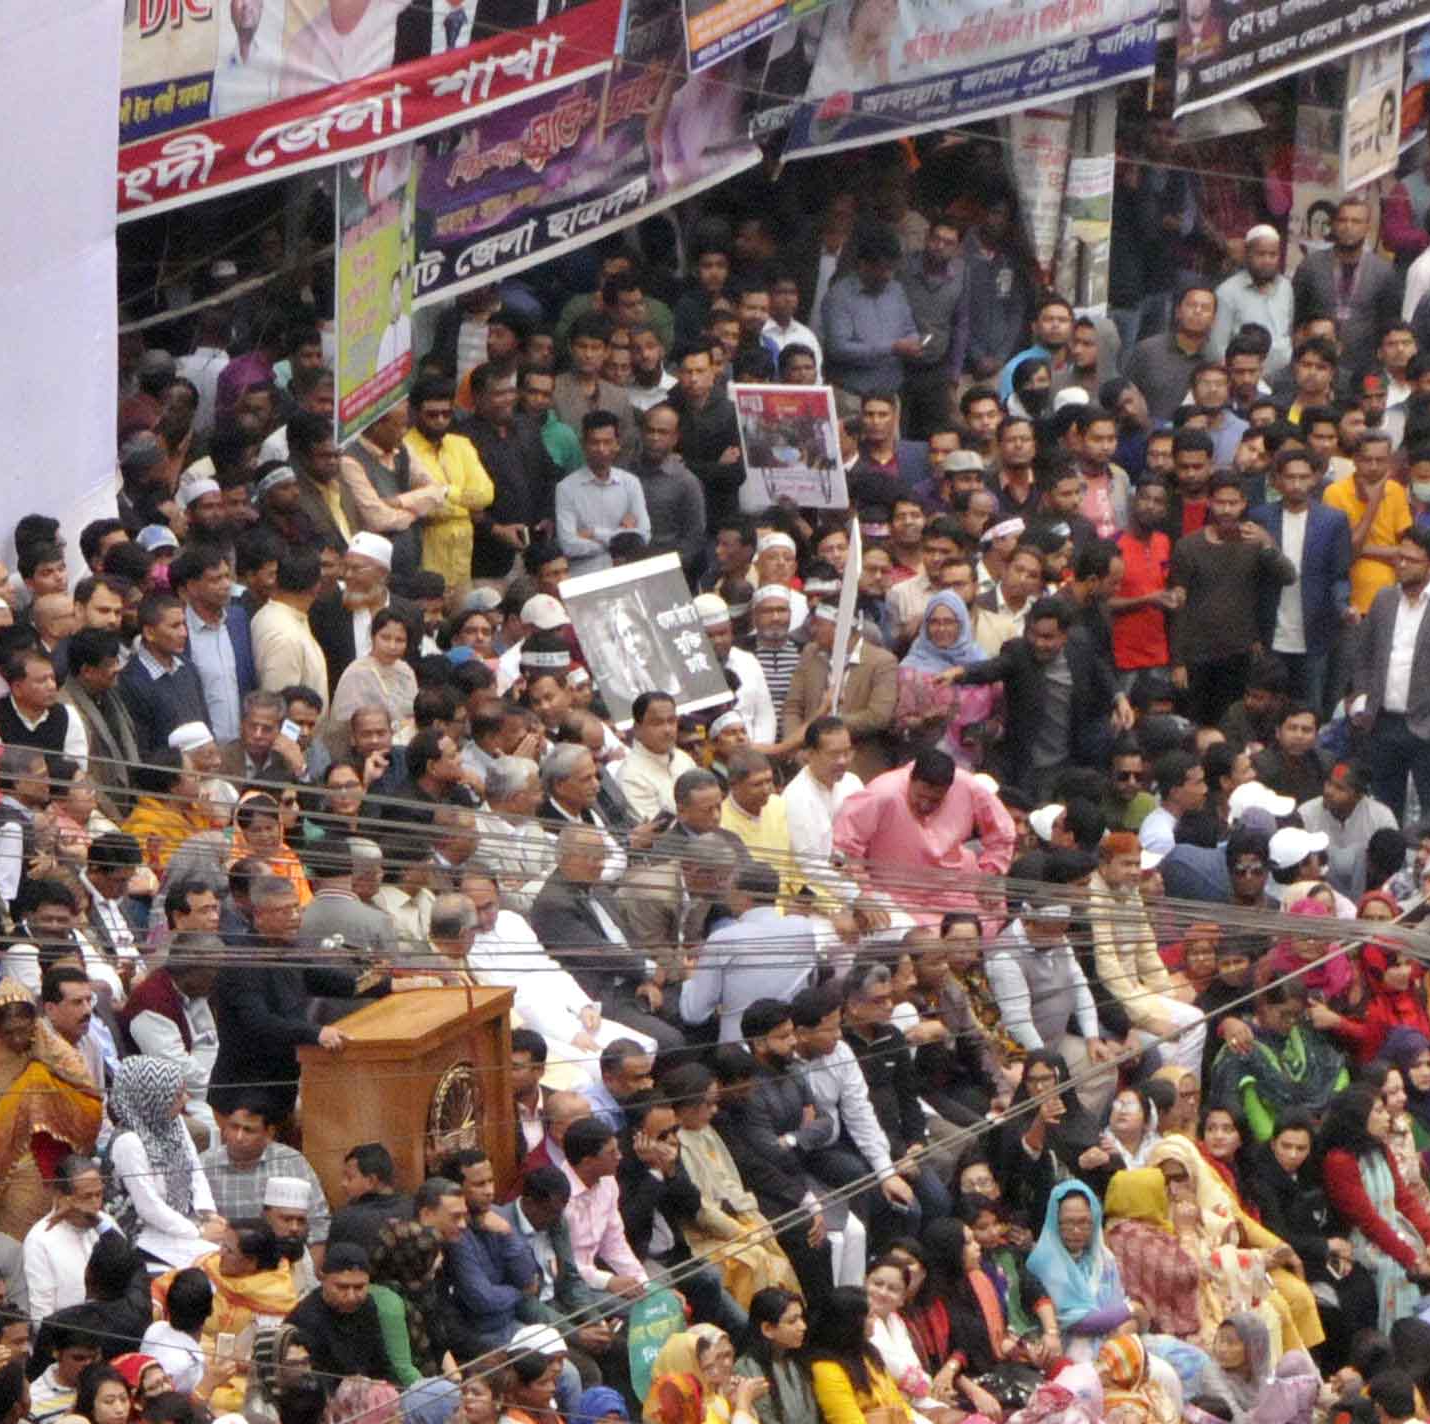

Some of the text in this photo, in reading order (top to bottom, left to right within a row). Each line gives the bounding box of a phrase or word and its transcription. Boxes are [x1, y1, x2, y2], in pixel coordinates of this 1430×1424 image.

[117, 132, 225, 203] ংদী
[246, 83, 411, 166] জেলা
[429, 31, 566, 103] শাখা
[456, 218, 537, 277] জেলা
[548, 175, 649, 240] ছাত্রদল
